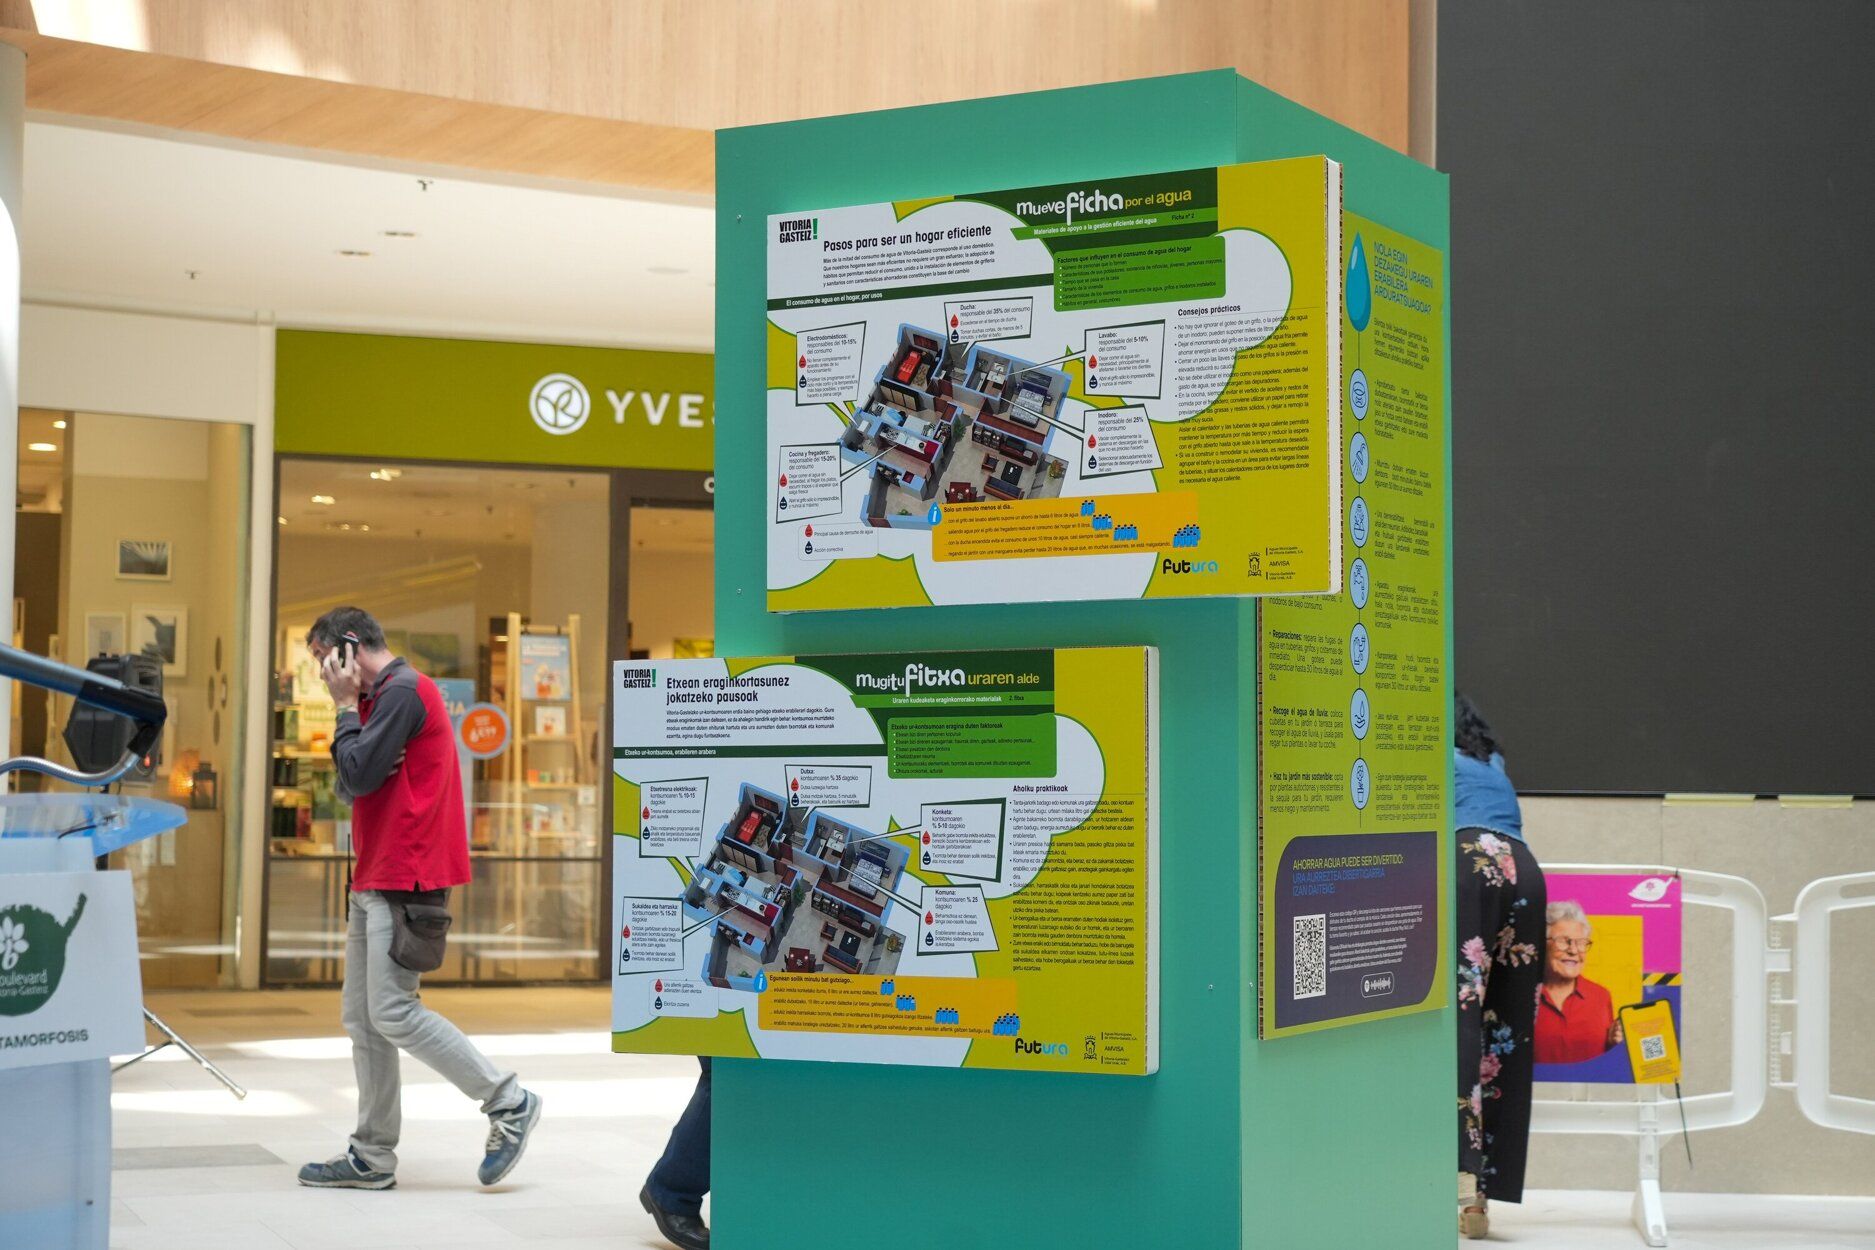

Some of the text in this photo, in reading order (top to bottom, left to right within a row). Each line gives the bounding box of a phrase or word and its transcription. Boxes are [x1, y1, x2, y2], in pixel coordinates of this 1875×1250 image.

[1125, 198, 1143, 209] por
[1145, 195, 1154, 204] el
[1156, 190, 1191, 206] agua
[780, 219, 811, 232] VITORIA
[780, 230, 811, 243] GASTEIZ
[824, 225, 991, 252] Pasos para ser un hogar eficiente
[1374, 241, 1392, 257] NOLA
[1178, 304, 1241, 317] Consejos prácticos
[605, 390, 714, 428] YVE
[1163, 558, 1219, 574] futura
[624, 669, 651, 678] VITORIA
[968, 673, 1014, 685] uraren
[1017, 673, 1040, 684] alde
[624, 679, 651, 688] GASTEIZ
[667, 676, 789, 690] Etxean eraginkortasunez
[666, 690, 758, 705] jokatzeko pausoak
[1036, 785, 1068, 793] praktikoak
[1293, 859, 1324, 870] AHORRAR
[1324, 858, 1340, 868] AGUA
[1341, 856, 1360, 867] PUEDE
[1361, 856, 1372, 866] SER
[1015, 1038, 1068, 1055] futura
